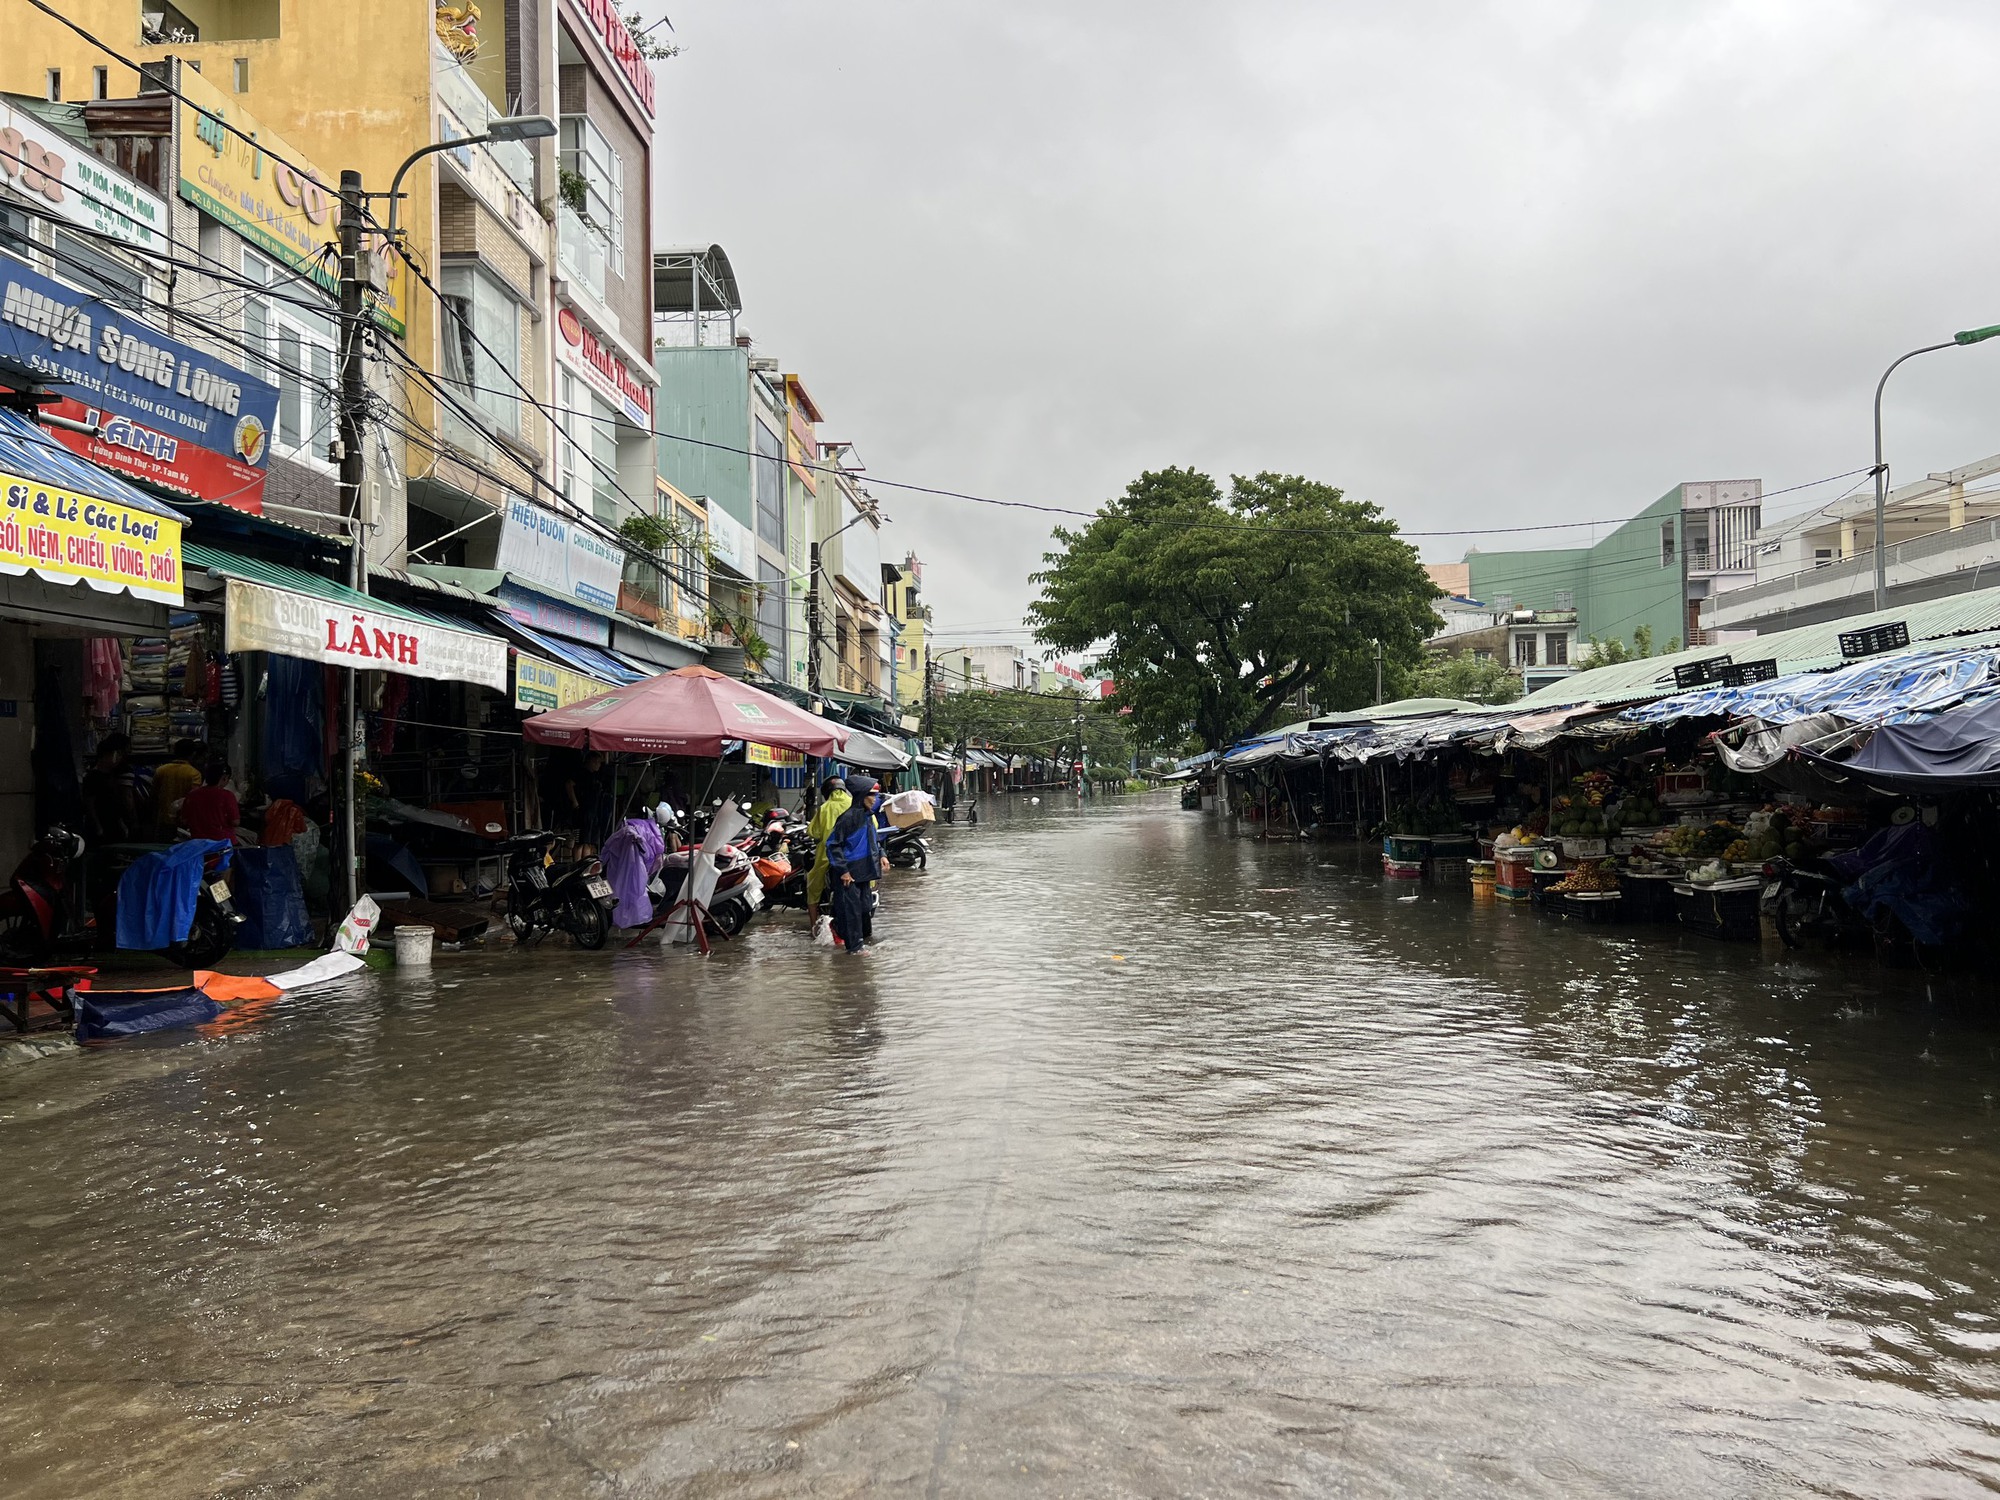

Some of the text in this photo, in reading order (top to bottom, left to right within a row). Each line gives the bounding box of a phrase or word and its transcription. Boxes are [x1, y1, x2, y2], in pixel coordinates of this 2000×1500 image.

[78, 162, 92, 184] TẠP
[2, 281, 241, 417] NHỰA SONG LONG
[582, 326, 615, 382] Minh
[615, 357, 650, 415] Thanh
[155, 404, 176, 422] GIA
[7, 485, 159, 545] Sỉ & Lẻ Các Loại
[28, 523, 63, 565] NỆM,
[67, 532, 108, 574] CHIẾU,
[111, 542, 148, 581] VÕNG,
[150, 548, 175, 583] CHỔI
[325, 614, 419, 666] LÃNH
